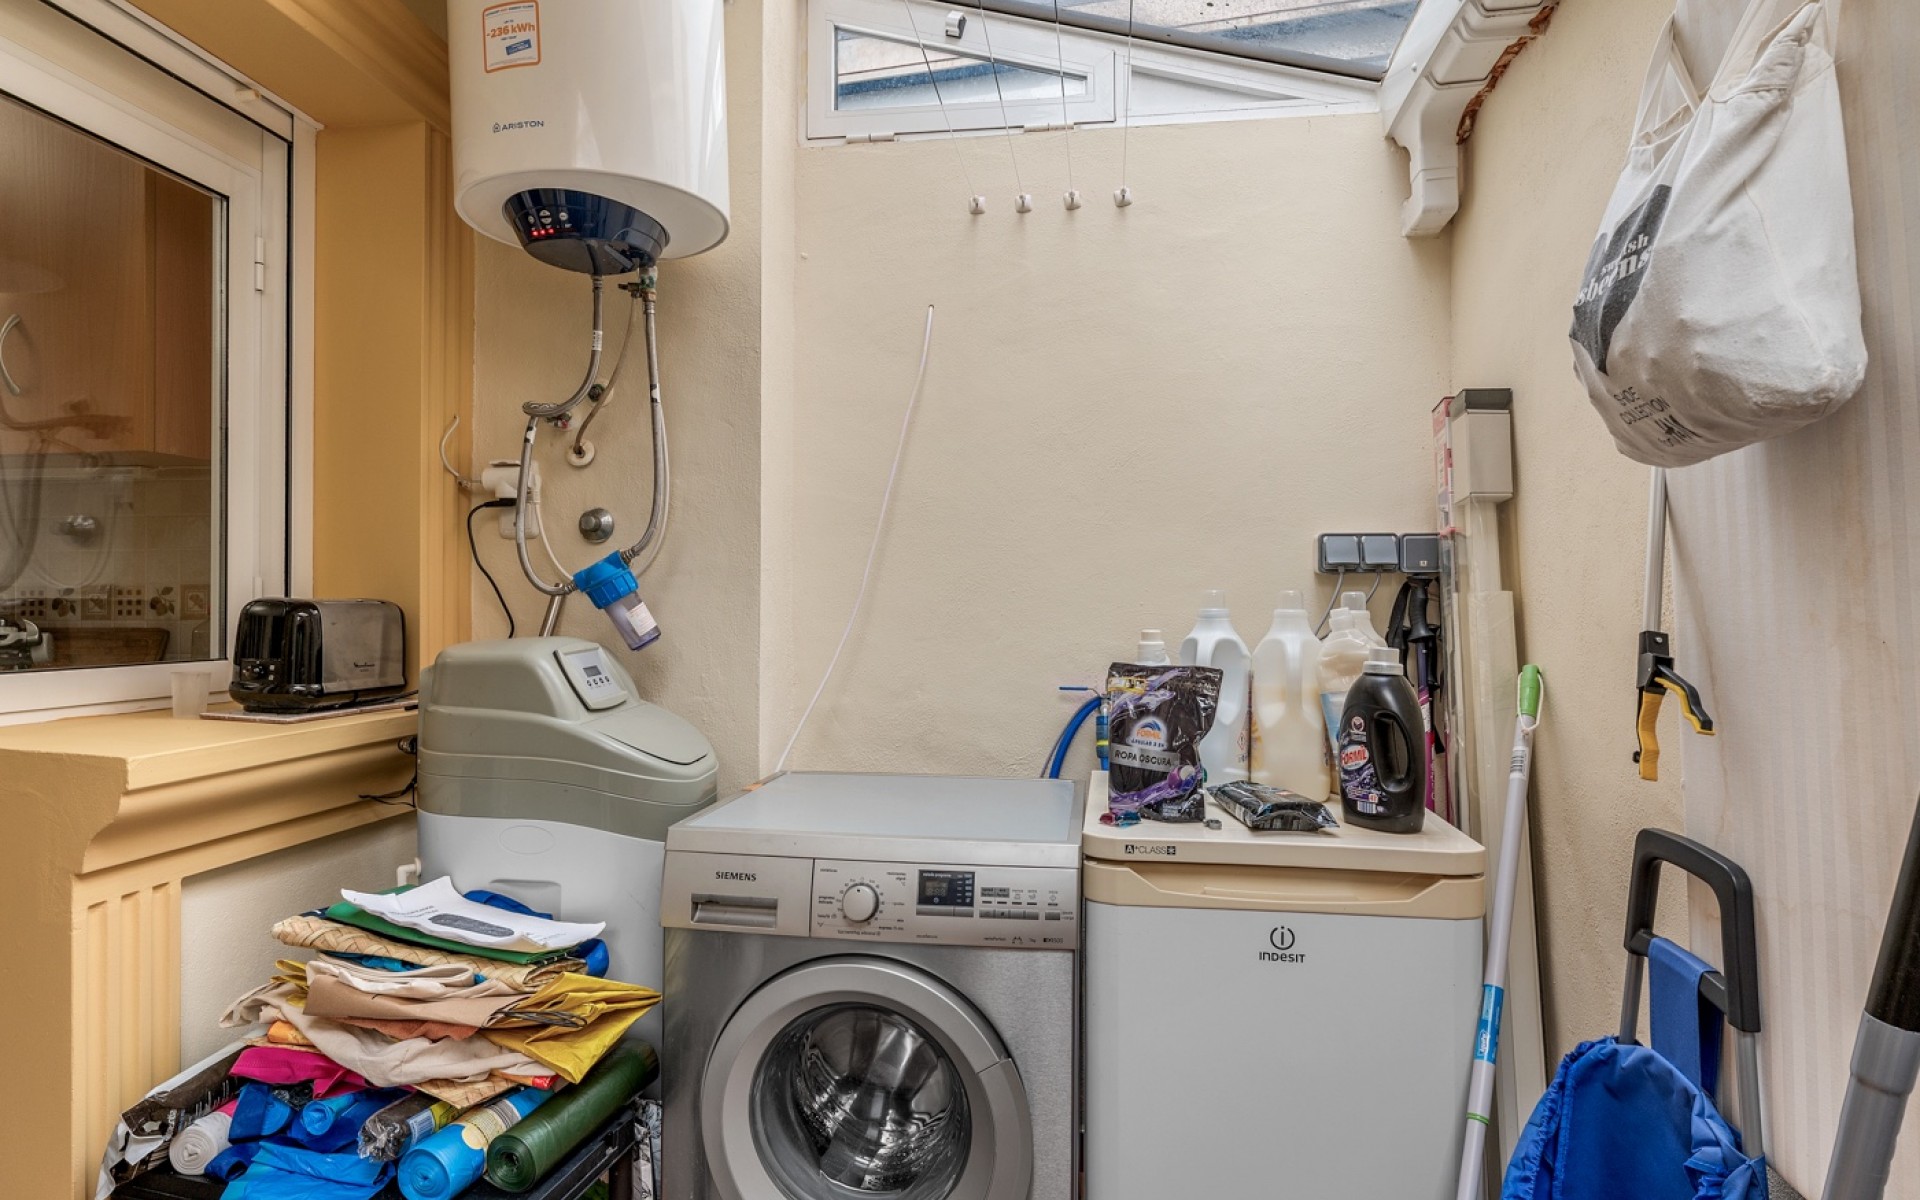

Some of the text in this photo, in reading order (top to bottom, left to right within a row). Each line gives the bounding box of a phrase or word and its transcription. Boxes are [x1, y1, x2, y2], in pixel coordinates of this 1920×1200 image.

[486, 25, 510, 38] -236
[511, 23, 536, 34] kWh
[501, 120, 544, 131] ARISTON
[1114, 749, 1172, 767] ROPA OSCURA
[715, 871, 757, 882] SIEMENS
